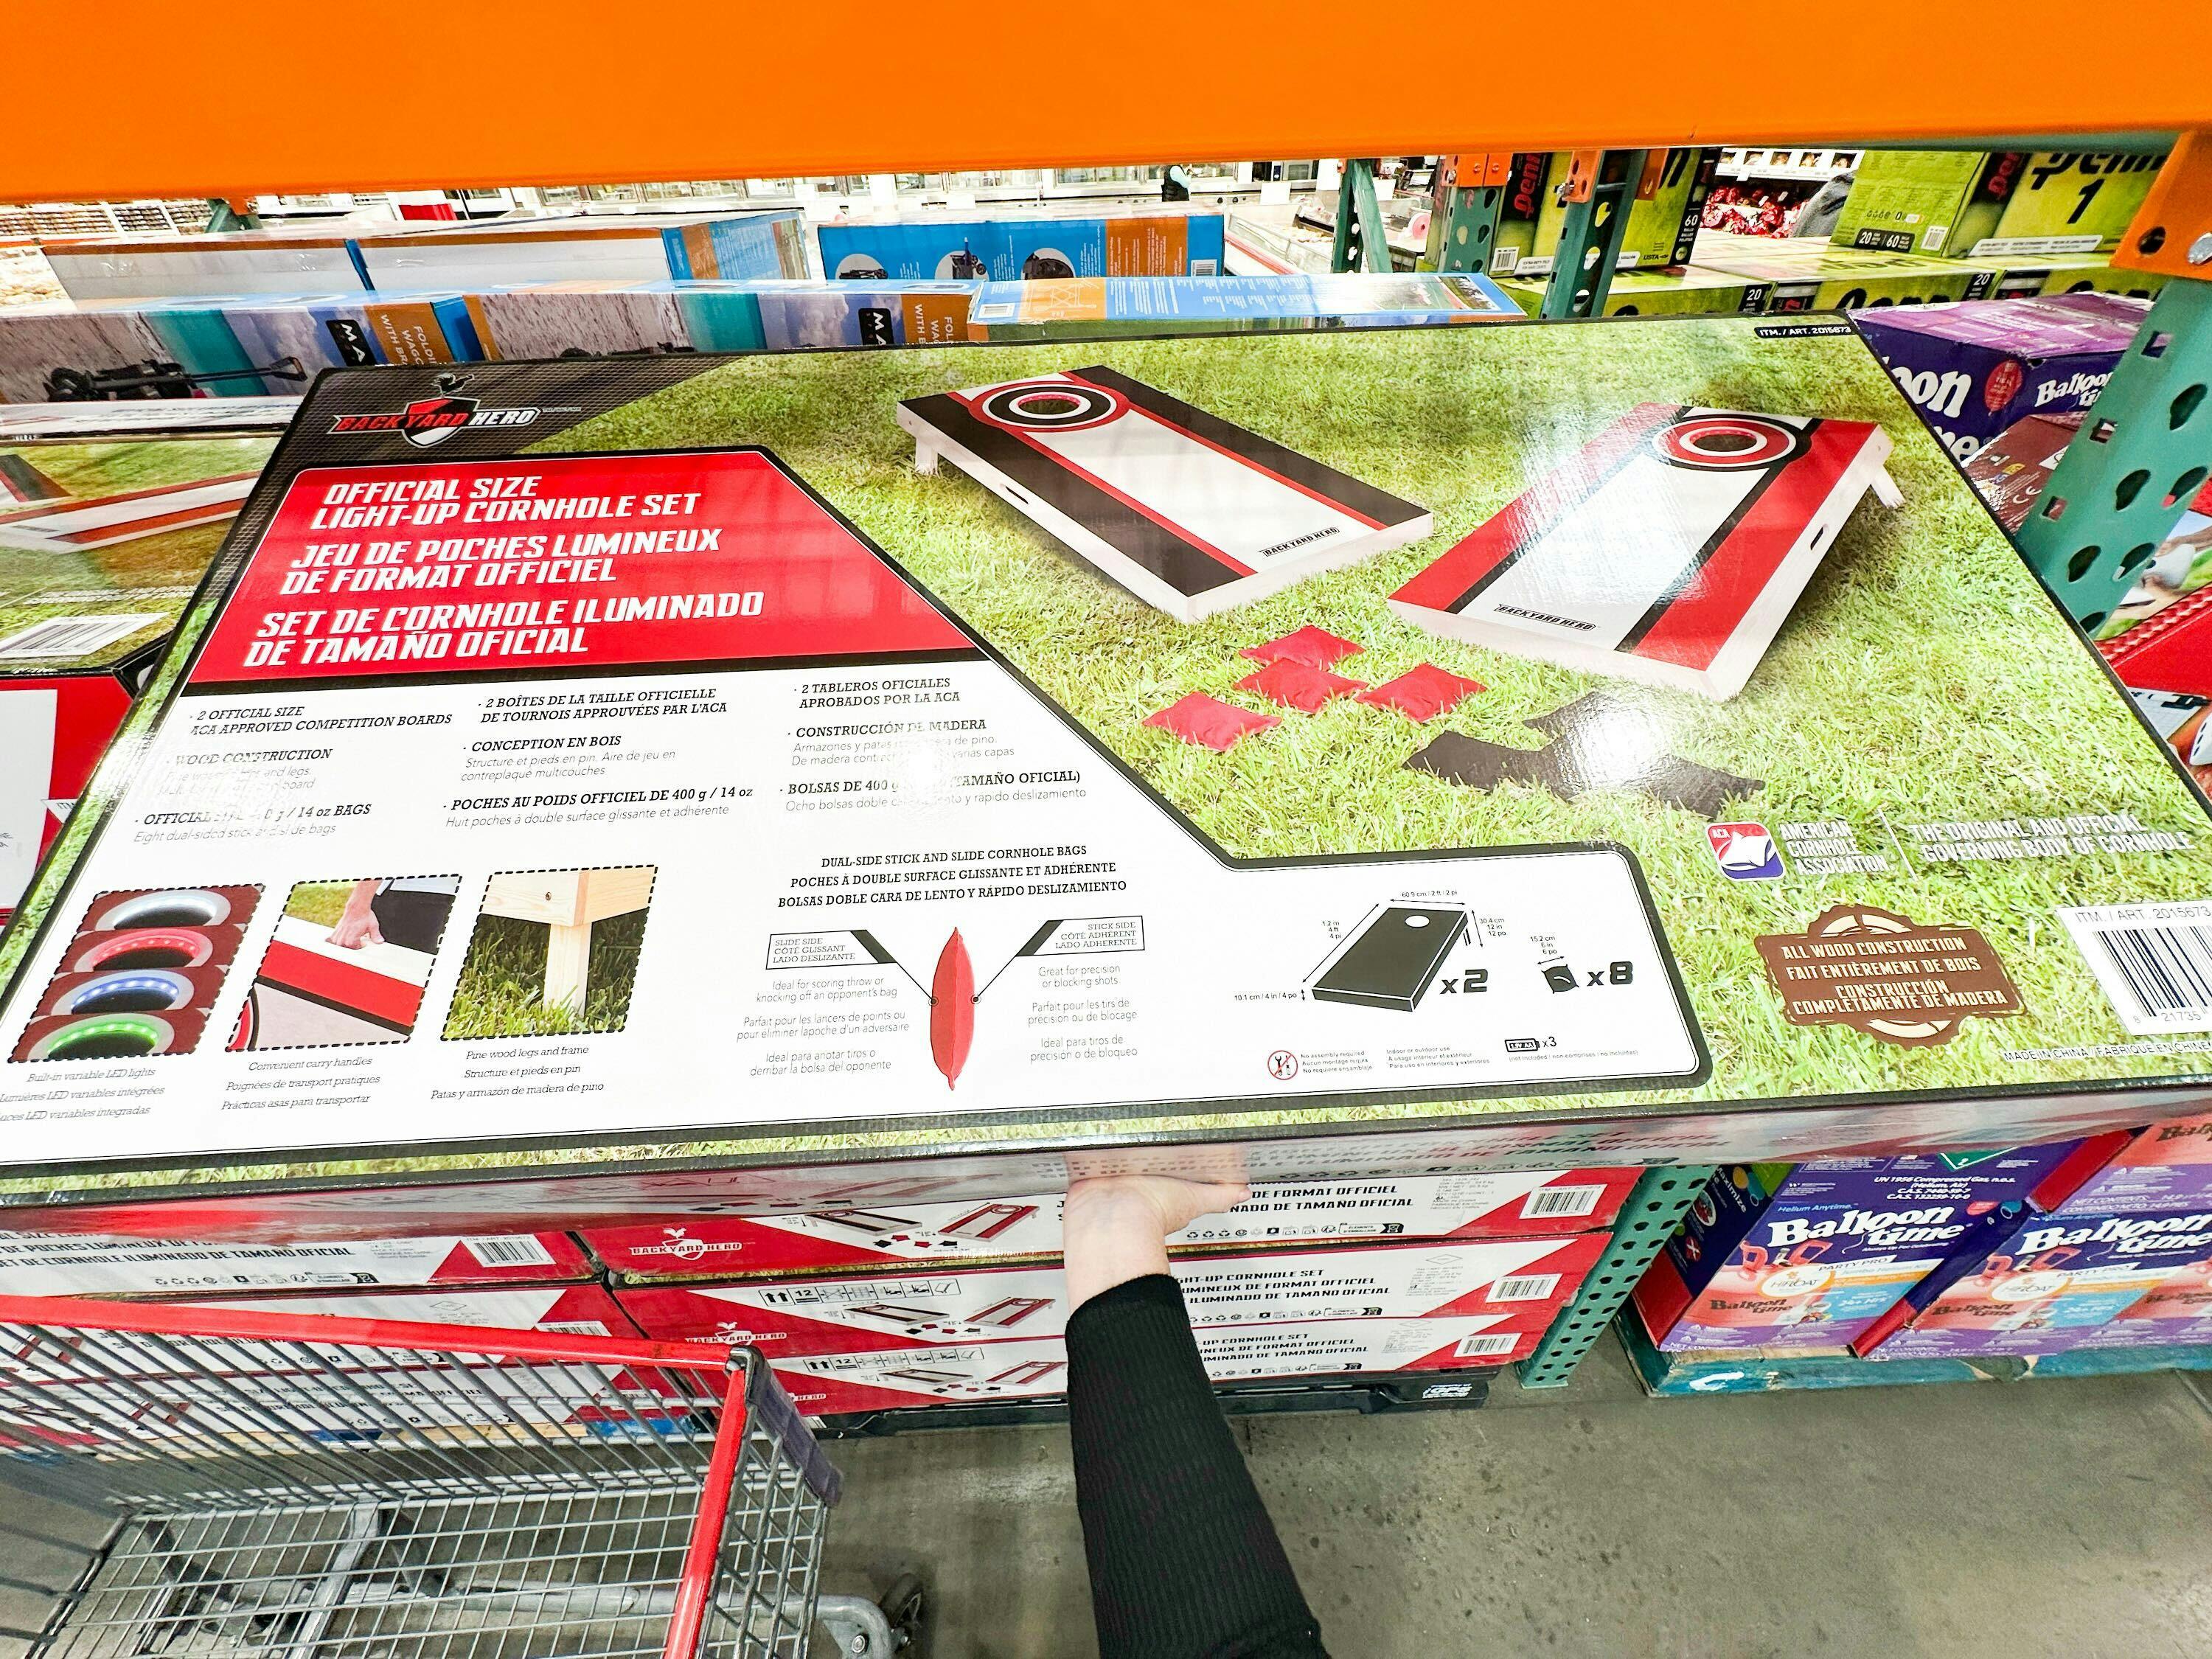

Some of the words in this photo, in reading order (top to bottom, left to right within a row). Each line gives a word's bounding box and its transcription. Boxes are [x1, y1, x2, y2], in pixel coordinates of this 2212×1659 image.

[2067, 178, 2104, 223] 1
[1685, 215, 1698, 226] 60
[1859, 232, 1871, 244] 20
[1886, 234, 1899, 248] 60
[1975, 274, 1990, 285] 20
[1747, 289, 1761, 301] 20
[916, 304, 925, 333] WITH
[380, 313, 398, 349] WITH
[335, 413, 468, 431] BACKYARD
[469, 409, 534, 425] HERO
[324, 480, 460, 504] OFFICIAL
[470, 476, 541, 498] SIZE
[310, 503, 459, 529] LIGHT-UP
[464, 496, 635, 522] CORNHOLE
[641, 493, 700, 515] SET
[291, 543, 361, 568] JEU
[364, 541, 411, 565] DE
[415, 536, 546, 563] POCHES
[552, 529, 722, 557] LUMINEUX
[1265, 536, 1313, 555] BACKYARD
[1314, 528, 1337, 539] HERO
[279, 571, 329, 594] DE
[330, 564, 472, 592] FORMAT
[475, 558, 616, 585] OFFICIEL
[257, 611, 327, 637] SET
[330, 608, 380, 633] DE
[381, 600, 568, 631] CORNHOLE
[573, 592, 764, 623] ILUMINADO
[1499, 606, 1560, 622] BACKYARD
[1560, 619, 1593, 630] HERO
[243, 640, 296, 667] DE
[301, 633, 452, 664] TAMAÑO
[456, 627, 588, 657] OFICIAL
[486, 698, 494, 708] 2
[496, 697, 545, 707] BOÎTES
[547, 695, 566, 705] DE
[568, 695, 585, 704] LA
[589, 692, 635, 703] TAILLE
[638, 689, 716, 701] OFFICIELLE
[197, 711, 206, 720] 2
[209, 708, 271, 720] OFFICIAL
[274, 706, 305, 717] SIZE
[218, 721, 292, 734] APPROVED
[296, 717, 395, 730] COMPETITION
[397, 714, 452, 726] BOARDS
[1711, 829, 1731, 839] ACA
[1778, 821, 1853, 840] AMERICAN
[1910, 824, 1941, 842] THE
[1945, 819, 2031, 841] ORIGINAL
[2032, 817, 2068, 836] AND
[2067, 814, 2149, 834] OFFICIAL
[821, 856, 882, 867] DUAL-SIDE
[885, 854, 919, 864] STICK
[922, 852, 947, 863] AND
[951, 851, 984, 860] SLIDE
[988, 847, 1054, 859] CORNHOLE
[1057, 846, 1086, 855] BAGS
[1785, 838, 1863, 858] CORNHOLE
[1921, 840, 2023, 862] GOVERNING
[2022, 836, 2070, 858] BODY
[2069, 835, 2097, 855] OF
[2097, 831, 2197, 854] CORNHOLE
[790, 877, 838, 888] POCHES
[841, 876, 849, 885] À
[852, 873, 901, 884] DOUBLE
[904, 871, 956, 882] SURFACE
[959, 867, 1023, 879] GLISSANTE
[1026, 866, 1040, 876] ET
[1044, 863, 1116, 875] ADHÉRENTE
[778, 896, 823, 907] BOLSAS
[826, 894, 867, 905] DOBLE
[871, 892, 902, 902] CARA
[905, 891, 921, 901] DE
[925, 889, 964, 900] LENTO
[967, 888, 975, 898] Y
[978, 886, 1024, 897] RÁPIDO
[1028, 881, 1127, 895] DESLIZAMIENTO
[2075, 912, 2107, 922] ITM.
[2153, 906, 2212, 919] 2015673
[1781, 946, 1810, 959] ALL
[1810, 942, 1855, 959] WOOD
[1855, 936, 1967, 956] CONSTRUCTION
[1587, 961, 1633, 987] x8
[1786, 965, 1818, 981] FAIT
[1823, 960, 1921, 979] ENTIÈREMENT
[1921, 959, 1944, 973] DE
[1946, 957, 1981, 971] BOIS
[1439, 969, 1488, 995] x2
[1834, 979, 1950, 998] CONSTRUCCIÓN
[1792, 996, 1921, 1015] COMPLETAMENTE
[1921, 994, 1944, 1008] DE
[1946, 990, 2008, 1006] MADERA
[2161, 1011, 2202, 1022] 21735
[1543, 1037, 1557, 1048] x3
[2003, 1051, 2037, 1060] MADE
[2039, 1051, 2051, 1060] IN
[2053, 1048, 2088, 1058] CHINA
[2096, 1045, 2155, 1056] FABRIQUE
[2157, 1043, 2171, 1053] EN
[2174, 1041, 2208, 1052] CHINE
[466, 1051, 487, 1060] Pine
[490, 1049, 517, 1058] wood
[518, 1048, 539, 1059] legs
[540, 1047, 560, 1055] and
[560, 1046, 588, 1054] frame
[248, 1061, 305, 1071] Convenient
[306, 1060, 333, 1069] carry
[333, 1057, 373, 1066] handles
[1252, 1190, 1270, 1198] DE
[1274, 1188, 1332, 1197] FORMAT
[1336, 1186, 1398, 1195] OFFICIEL
[1274, 1201, 1289, 1211] DE
[1360, 1197, 1413, 1207] OFICIAL
[1767, 1207, 1954, 1247] Balloon
[1868, 1225, 1964, 1245] time
[2015, 1214, 2212, 1255] Balloon
[23, 1257, 42, 1266] DE
[44, 1253, 124, 1265] CORNHOLE
[125, 1251, 210, 1263] ILUMINADO
[212, 1251, 231, 1259] DE
[298, 1248, 355, 1256] OFICIAL
[633, 1244, 703, 1253] BACKYARD
[1819, 1262, 1859, 1271] PARTY
[1861, 1257, 1888, 1266] PRO
[1227, 1270, 1293, 1281] CORNHOLE
[1710, 1298, 1787, 1310] Balloon
[1753, 1303, 1792, 1313] time
